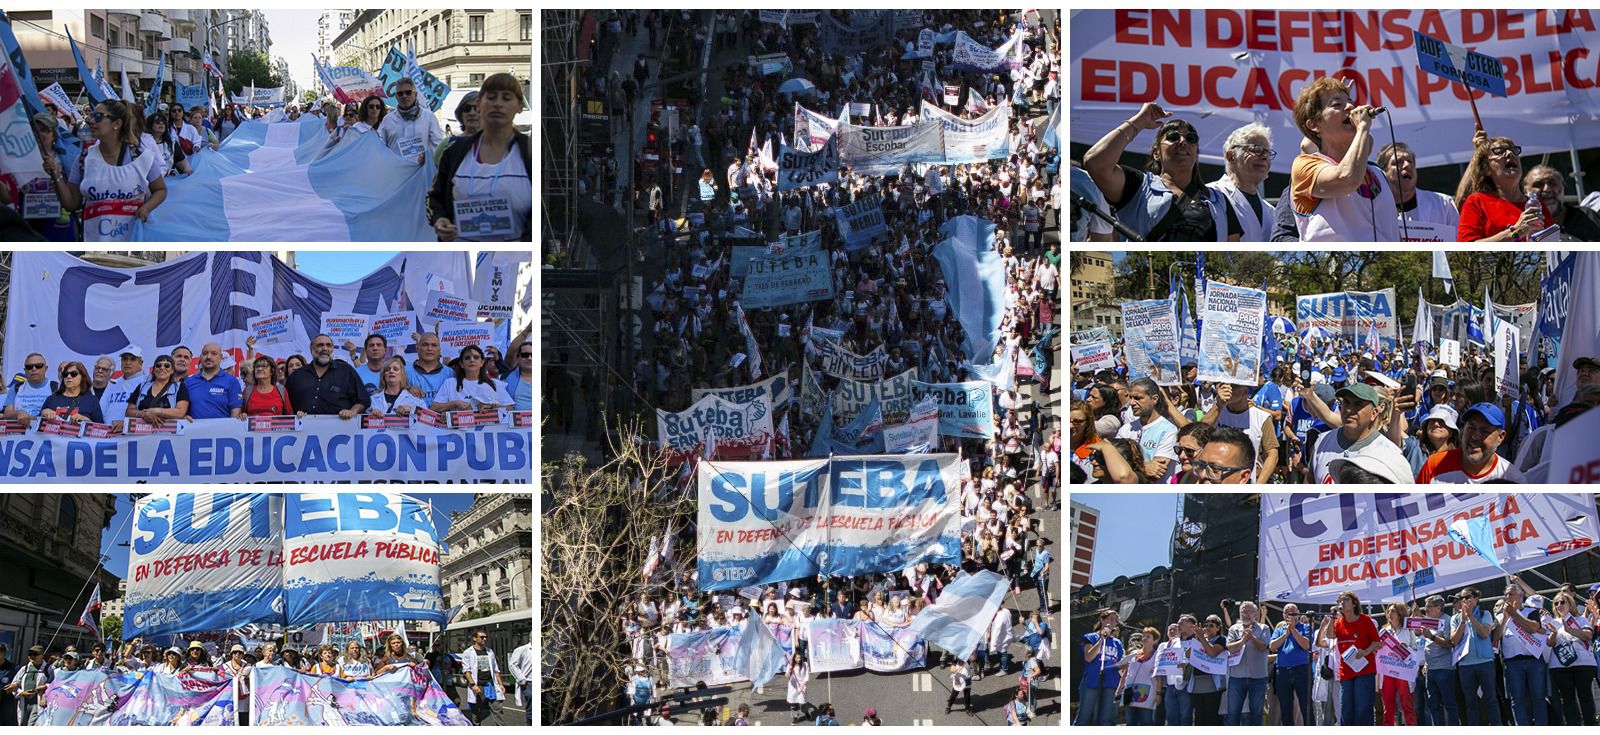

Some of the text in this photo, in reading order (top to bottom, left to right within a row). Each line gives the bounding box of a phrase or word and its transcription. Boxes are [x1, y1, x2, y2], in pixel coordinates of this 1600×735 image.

[1115, 9, 1596, 53] EN DEFENSA DE LA
[1419, 34, 1503, 79] ADF CTERA
[1081, 56, 1407, 111] EDUCACÓN
[1434, 61, 1491, 89] FORMOSA
[865, 140, 907, 152] Escobar
[58, 251, 414, 356] CTERA
[477, 304, 513, 312] UCUMAN
[1208, 297, 1236, 306] NACIONAL
[1208, 304, 1239, 313] DE LUCHA
[1210, 290, 1237, 300] JORNADA
[1297, 292, 1393, 320] SUTEBA
[1125, 306, 1148, 315] JORNADA
[1133, 319, 1152, 328] LUCHA
[1239, 313, 1260, 325] PARO
[1153, 322, 1172, 331] PARO
[664, 400, 744, 437] Suteba
[881, 398, 913, 416] LORES
[66, 440, 118, 478] DE
[127, 439, 180, 477] LA
[189, 425, 427, 477] EDUCACIÓN
[437, 425, 532, 472] PÚB
[1142, 440, 1158, 449] UTE
[709, 459, 948, 523] SUTEBA
[134, 493, 443, 556] SUTEBA
[716, 530, 733, 544] EN
[737, 523, 792, 543] DEFENSA
[830, 514, 883, 530] ESCUELA
[1319, 541, 1345, 563] EN
[1348, 518, 1449, 558] DEFENSA
[1488, 495, 1521, 522] LA
[135, 538, 439, 583] EN DEFENSA DE LA ESCUELA PÚBLICA
[1308, 549, 1429, 588] EDUCACIÓN
[133, 608, 182, 628] CTERA
